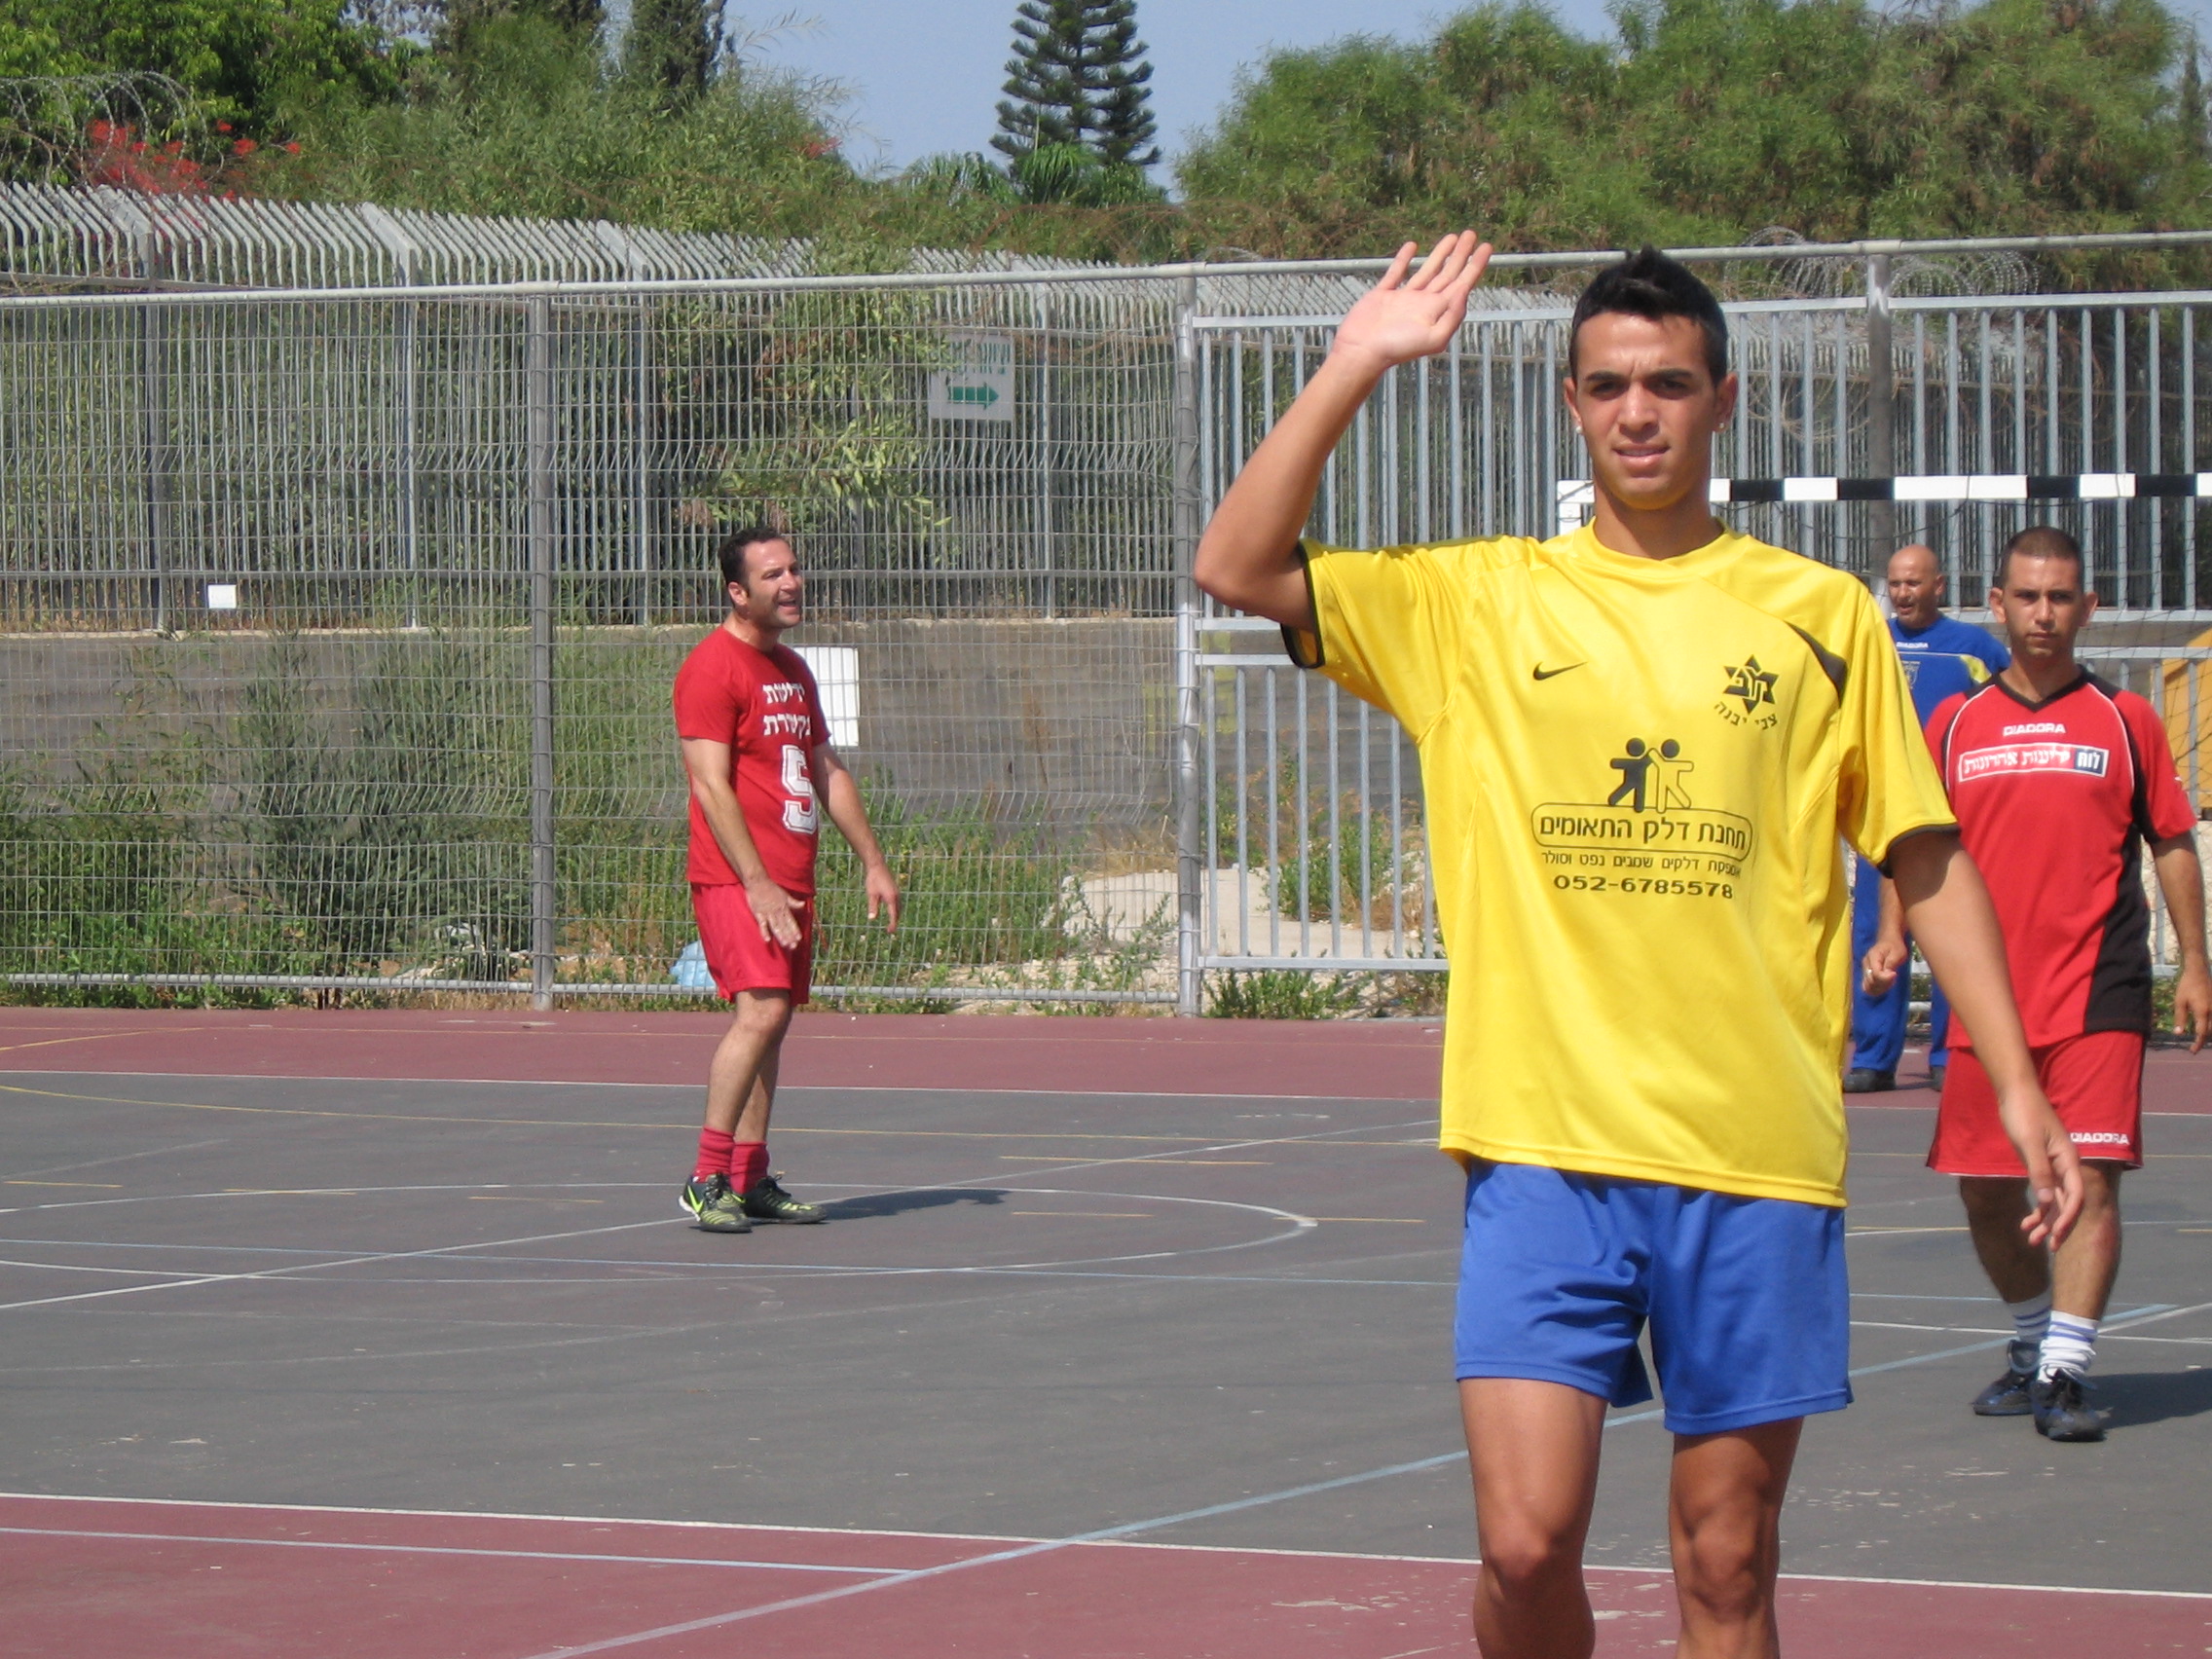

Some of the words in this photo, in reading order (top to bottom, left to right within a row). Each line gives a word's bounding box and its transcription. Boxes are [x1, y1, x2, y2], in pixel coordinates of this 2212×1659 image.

[1714, 701, 1748, 726] יבנה
[2002, 722, 2066, 737] DIADORA
[781, 744, 820, 834] 5
[1540, 816, 1632, 838] התאומים
[1643, 817, 1690, 844] דלק
[1697, 823, 1746, 850] תחנת
[1541, 850, 1572, 865] וסולר
[1579, 854, 1605, 866] נפט
[1613, 855, 1654, 868] שמנים
[1661, 857, 1700, 872] דלקים
[1553, 874, 1733, 900] 052-6785578
[2070, 1131, 2130, 1145] DIADORA
